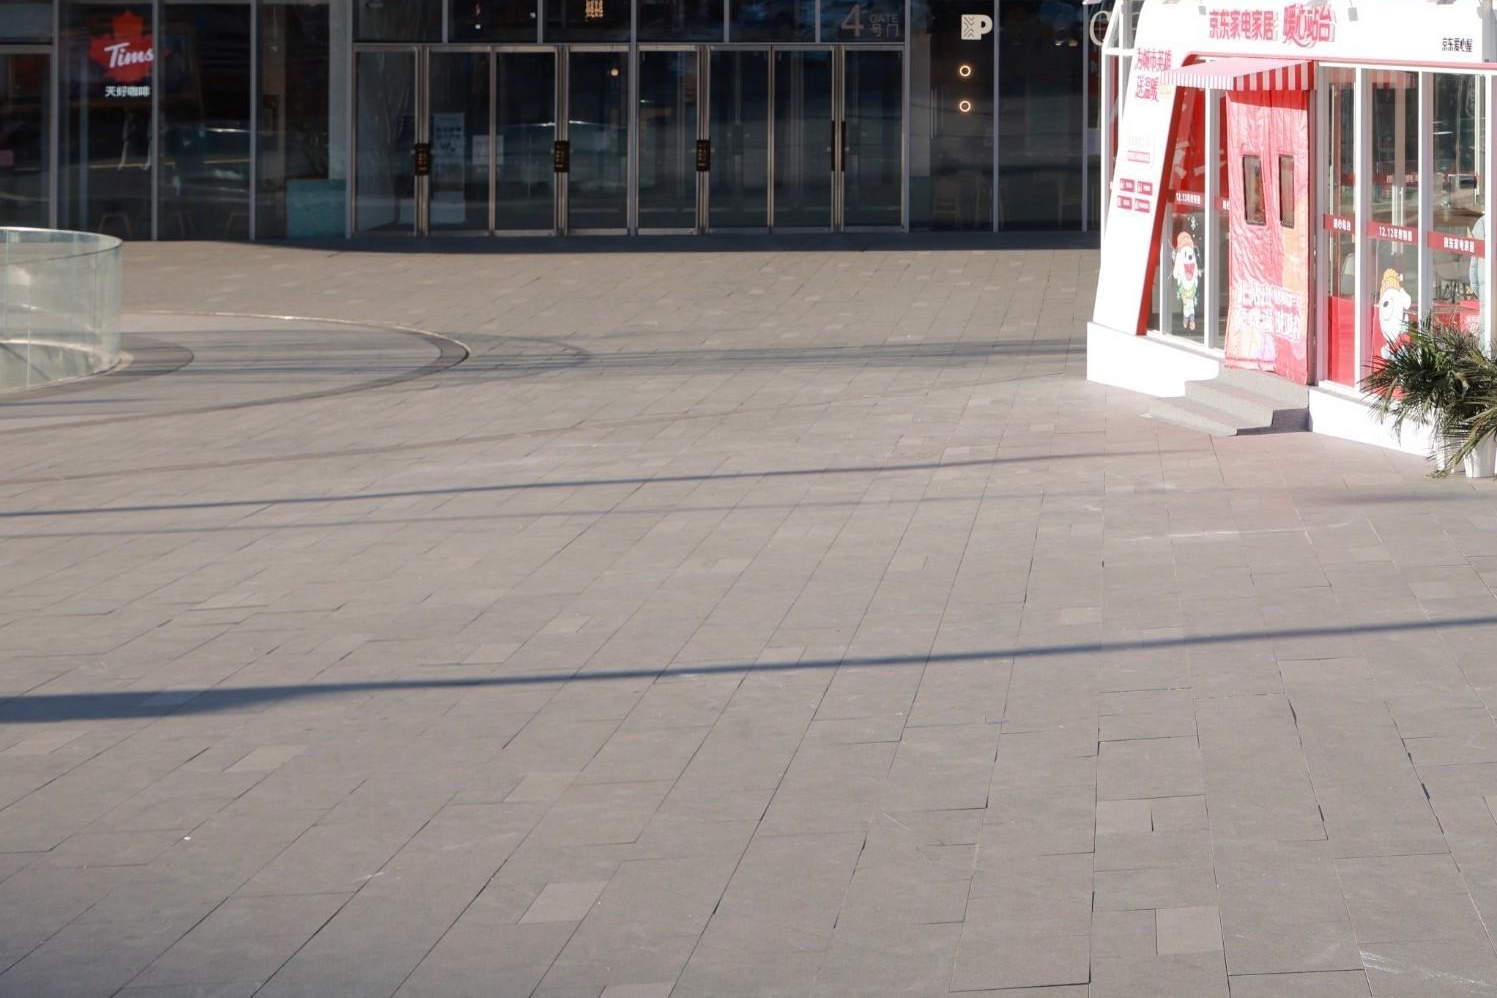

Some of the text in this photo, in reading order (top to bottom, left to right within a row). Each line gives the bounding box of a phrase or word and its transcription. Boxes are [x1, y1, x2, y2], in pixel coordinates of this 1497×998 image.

[841, 4, 864, 38] 4
[870, 13, 900, 23] GATE
[1208, 8, 1275, 41] 京东家电家居
[870, 23, 900, 38] 号门
[104, 42, 154, 69] Tims
[105, 86, 151, 97] 天好咖啡
